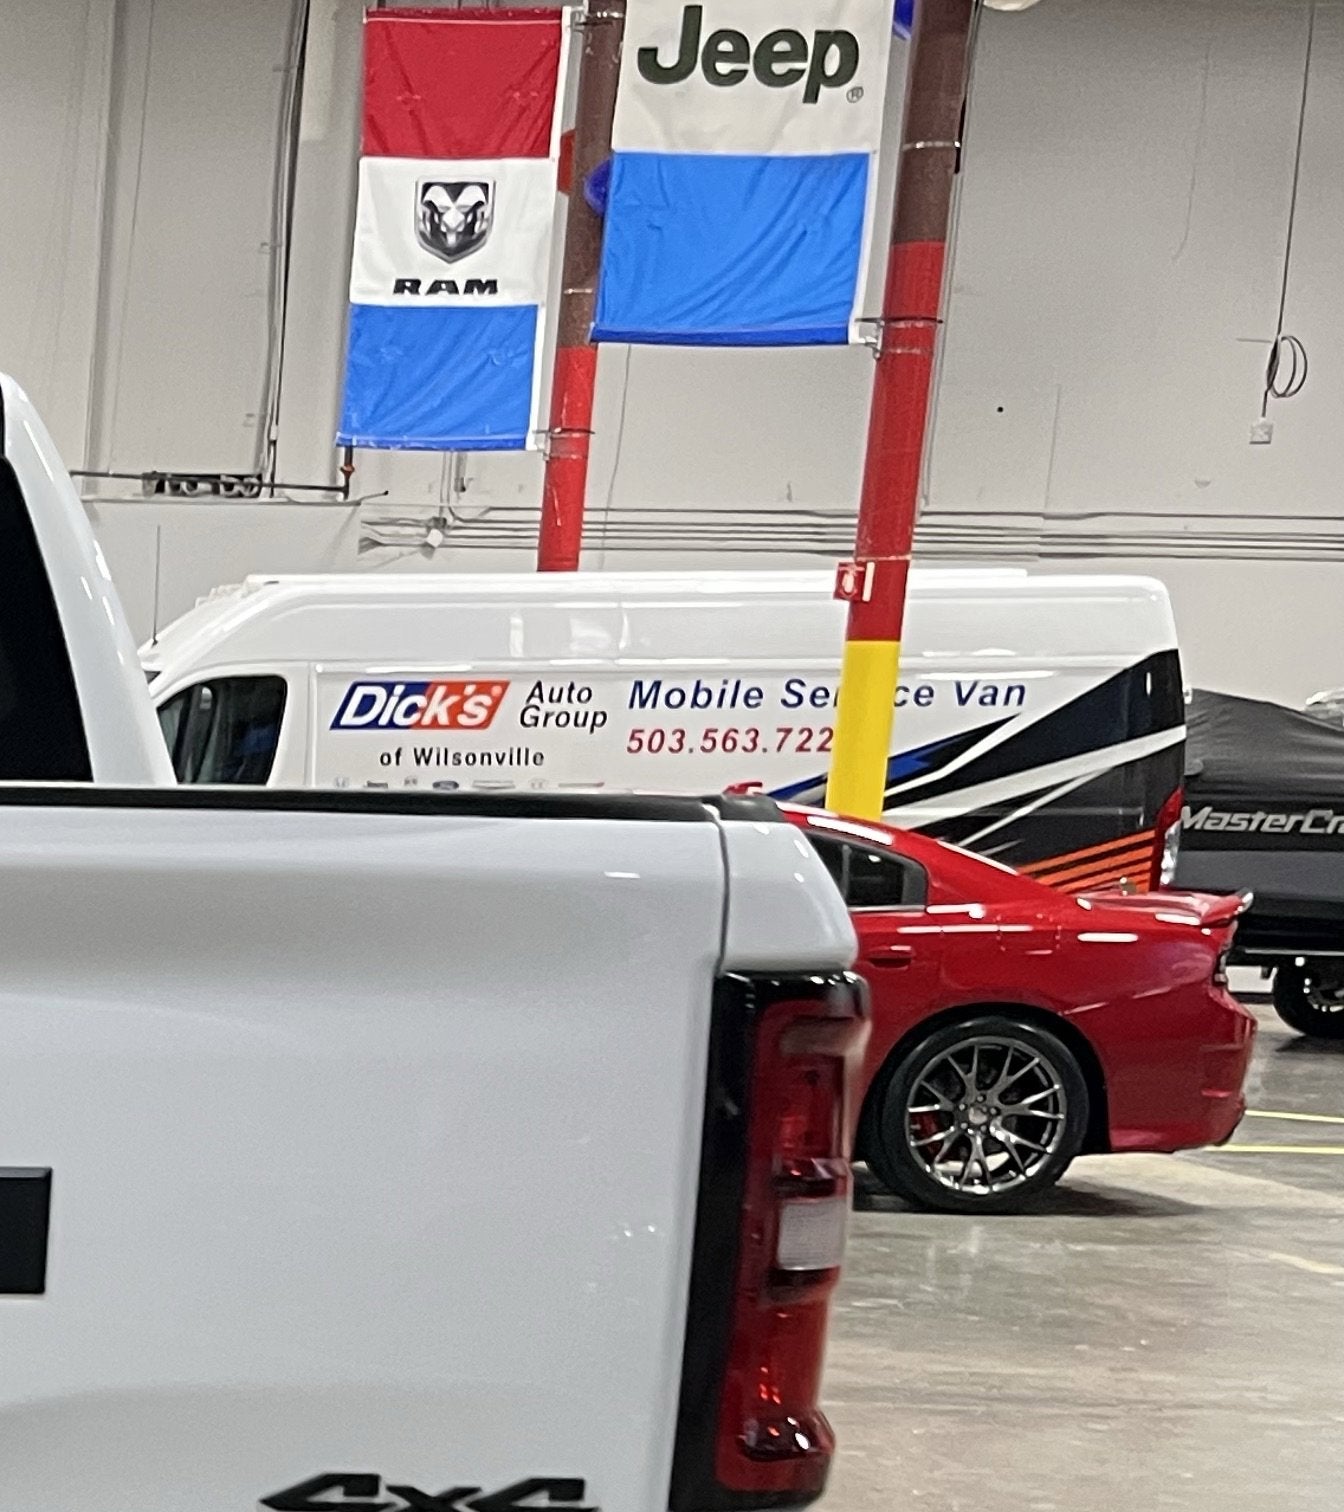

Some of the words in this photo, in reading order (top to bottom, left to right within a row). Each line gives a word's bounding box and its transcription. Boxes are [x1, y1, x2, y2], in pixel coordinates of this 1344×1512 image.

[637, 4, 860, 104] Jeep
[392, 278, 499, 297] RAM
[339, 684, 494, 728] Dick's
[525, 680, 593, 705] Auto
[628, 678, 765, 709] Mobile
[780, 678, 935, 708] Sece
[953, 679, 1028, 708] Van
[519, 704, 608, 734] Group
[625, 726, 835, 754] 503.563.722
[379, 747, 402, 767] of
[412, 746, 545, 767] Wilsonville
